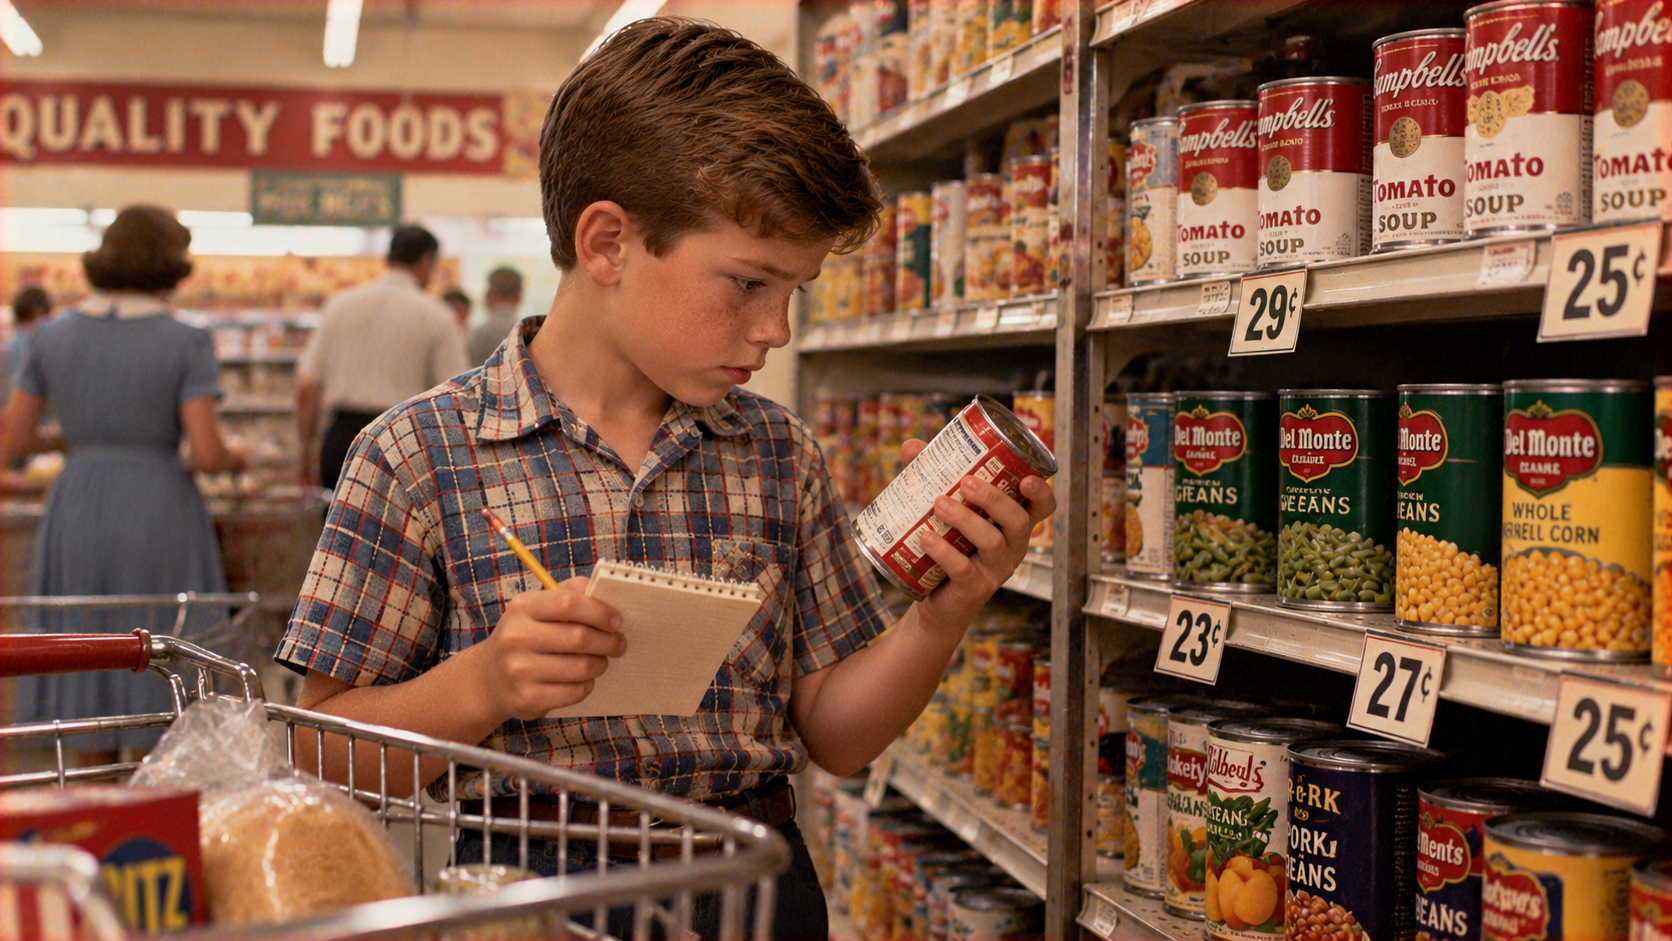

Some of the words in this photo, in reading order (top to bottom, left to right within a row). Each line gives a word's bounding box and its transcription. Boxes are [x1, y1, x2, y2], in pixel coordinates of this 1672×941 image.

[1465, 21, 1559, 76] ampbell's
[1373, 51, 1467, 99] Campbells
[0, 93, 282, 161] QUALITY
[311, 103, 500, 162] FOODS
[1258, 97, 1336, 139] ampbell's
[1466, 194, 1524, 218] SOUP
[1600, 188, 1667, 213] SOUP
[1378, 212, 1437, 233] SOUP
[1183, 251, 1231, 267] SOUP
[1260, 237, 1304, 257] SOUP
[1562, 243, 1647, 321] 25¢
[1243, 283, 1299, 342] 29¢
[1175, 425, 1190, 446] Del
[1192, 426, 1241, 447] Monte
[1280, 427, 1296, 449] Del
[1298, 428, 1352, 450] Monte
[1400, 427, 1441, 451] Monte
[1505, 428, 1525, 455] Del
[1527, 429, 1595, 458] Monte
[1397, 501, 1440, 523] EANS
[1512, 502, 1572, 521] WHOLE
[1550, 525, 1600, 544] CORN
[1169, 609, 1221, 667] 23¢
[1366, 651, 1433, 723] 27¢
[1566, 698, 1654, 782] 25¢
